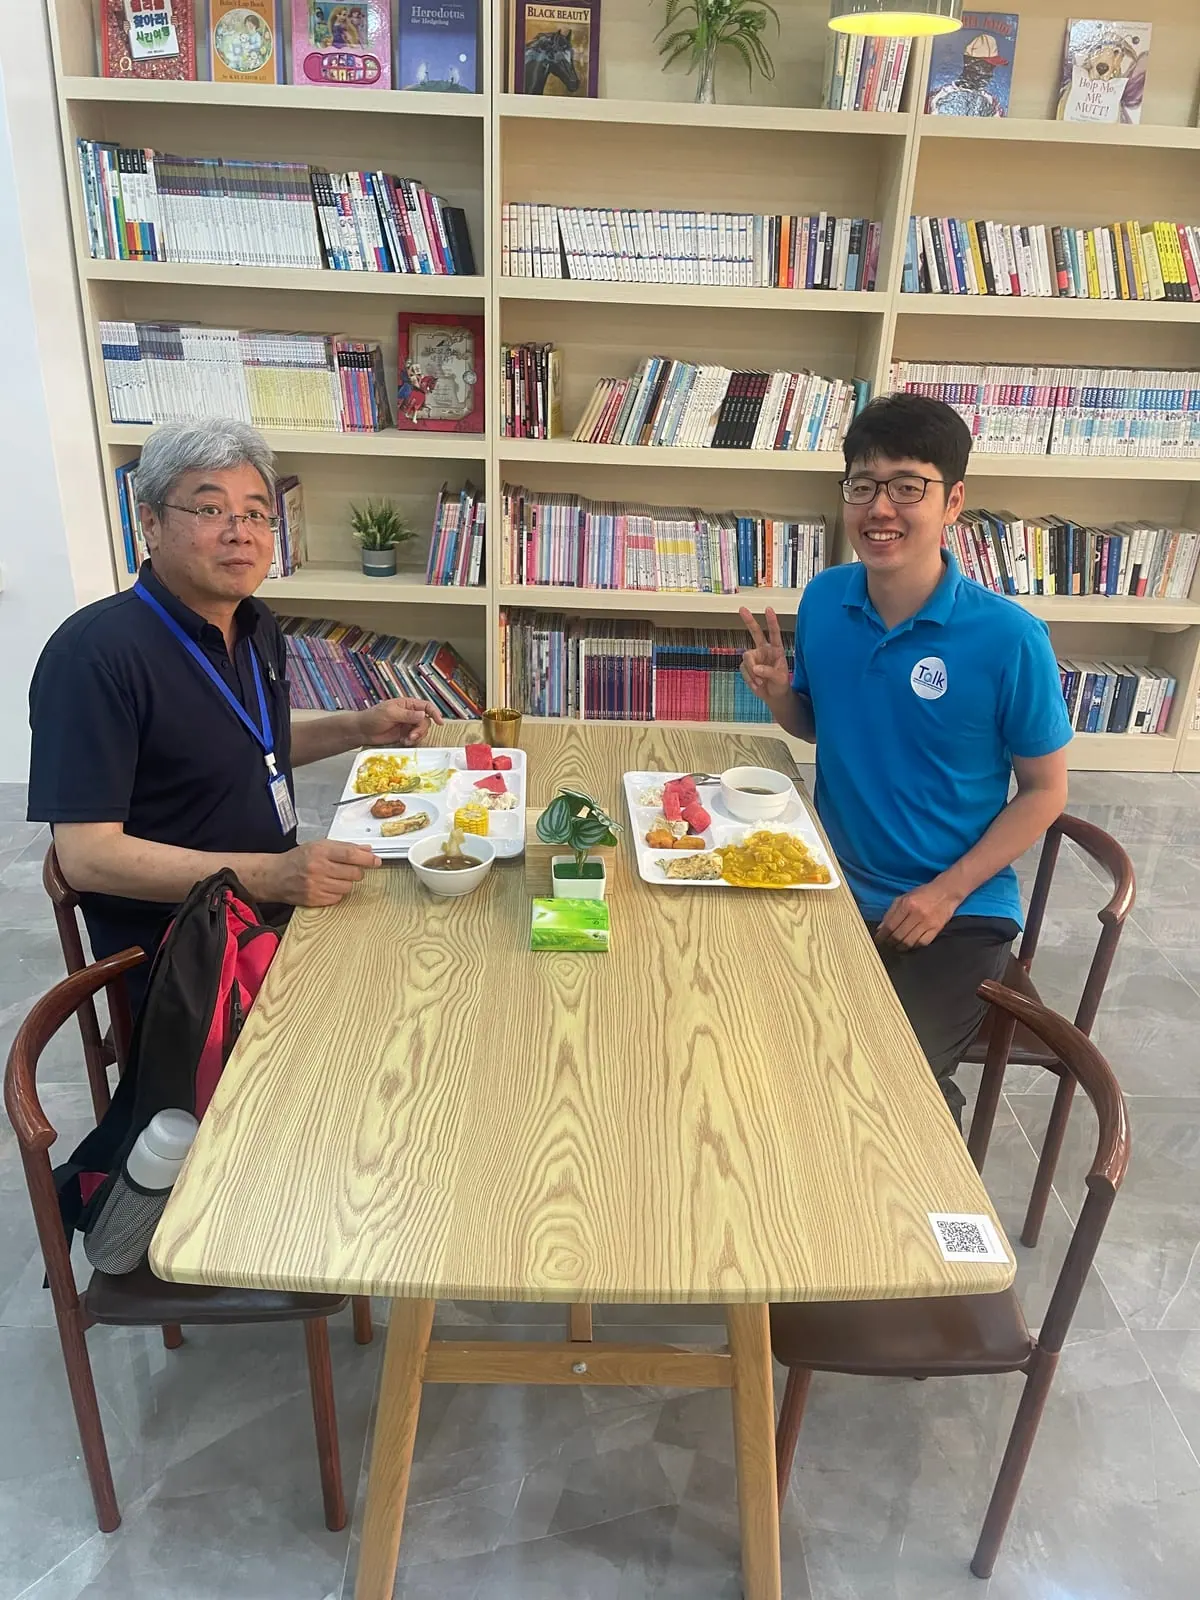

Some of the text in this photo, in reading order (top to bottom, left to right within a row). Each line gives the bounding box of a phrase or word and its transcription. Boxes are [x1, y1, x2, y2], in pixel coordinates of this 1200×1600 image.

[411, 6, 465, 19] Herodotus
[527, 6, 590, 21] BLACK BEAUTY
[1079, 77, 1099, 92] Help
[1075, 102, 1110, 116] MUTT!
[919, 665, 945, 689] Talk
